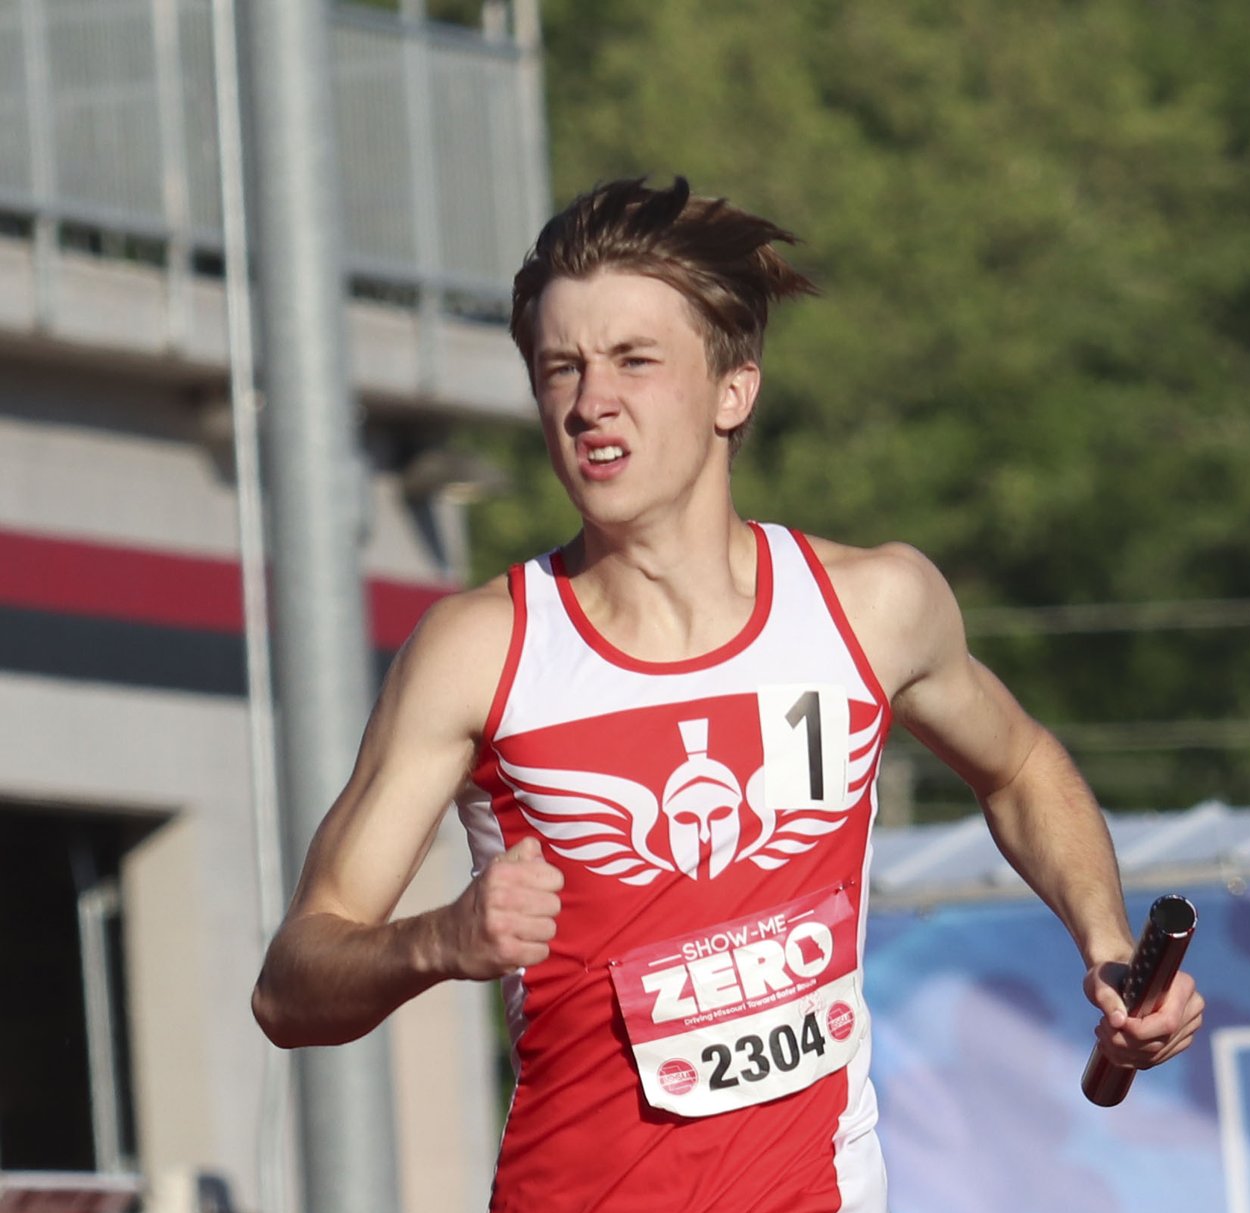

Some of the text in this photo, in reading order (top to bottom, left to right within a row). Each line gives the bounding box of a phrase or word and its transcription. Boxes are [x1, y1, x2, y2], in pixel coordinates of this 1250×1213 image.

[785, 690, 825, 801] 1
[641, 921, 834, 1025] ZERO
[682, 914, 787, 961] SHOW-ME
[683, 1010, 714, 1027] Driving
[713, 1004, 747, 1018] Missouri
[746, 994, 777, 1009] Toward
[701, 1011, 826, 1091] 2304
